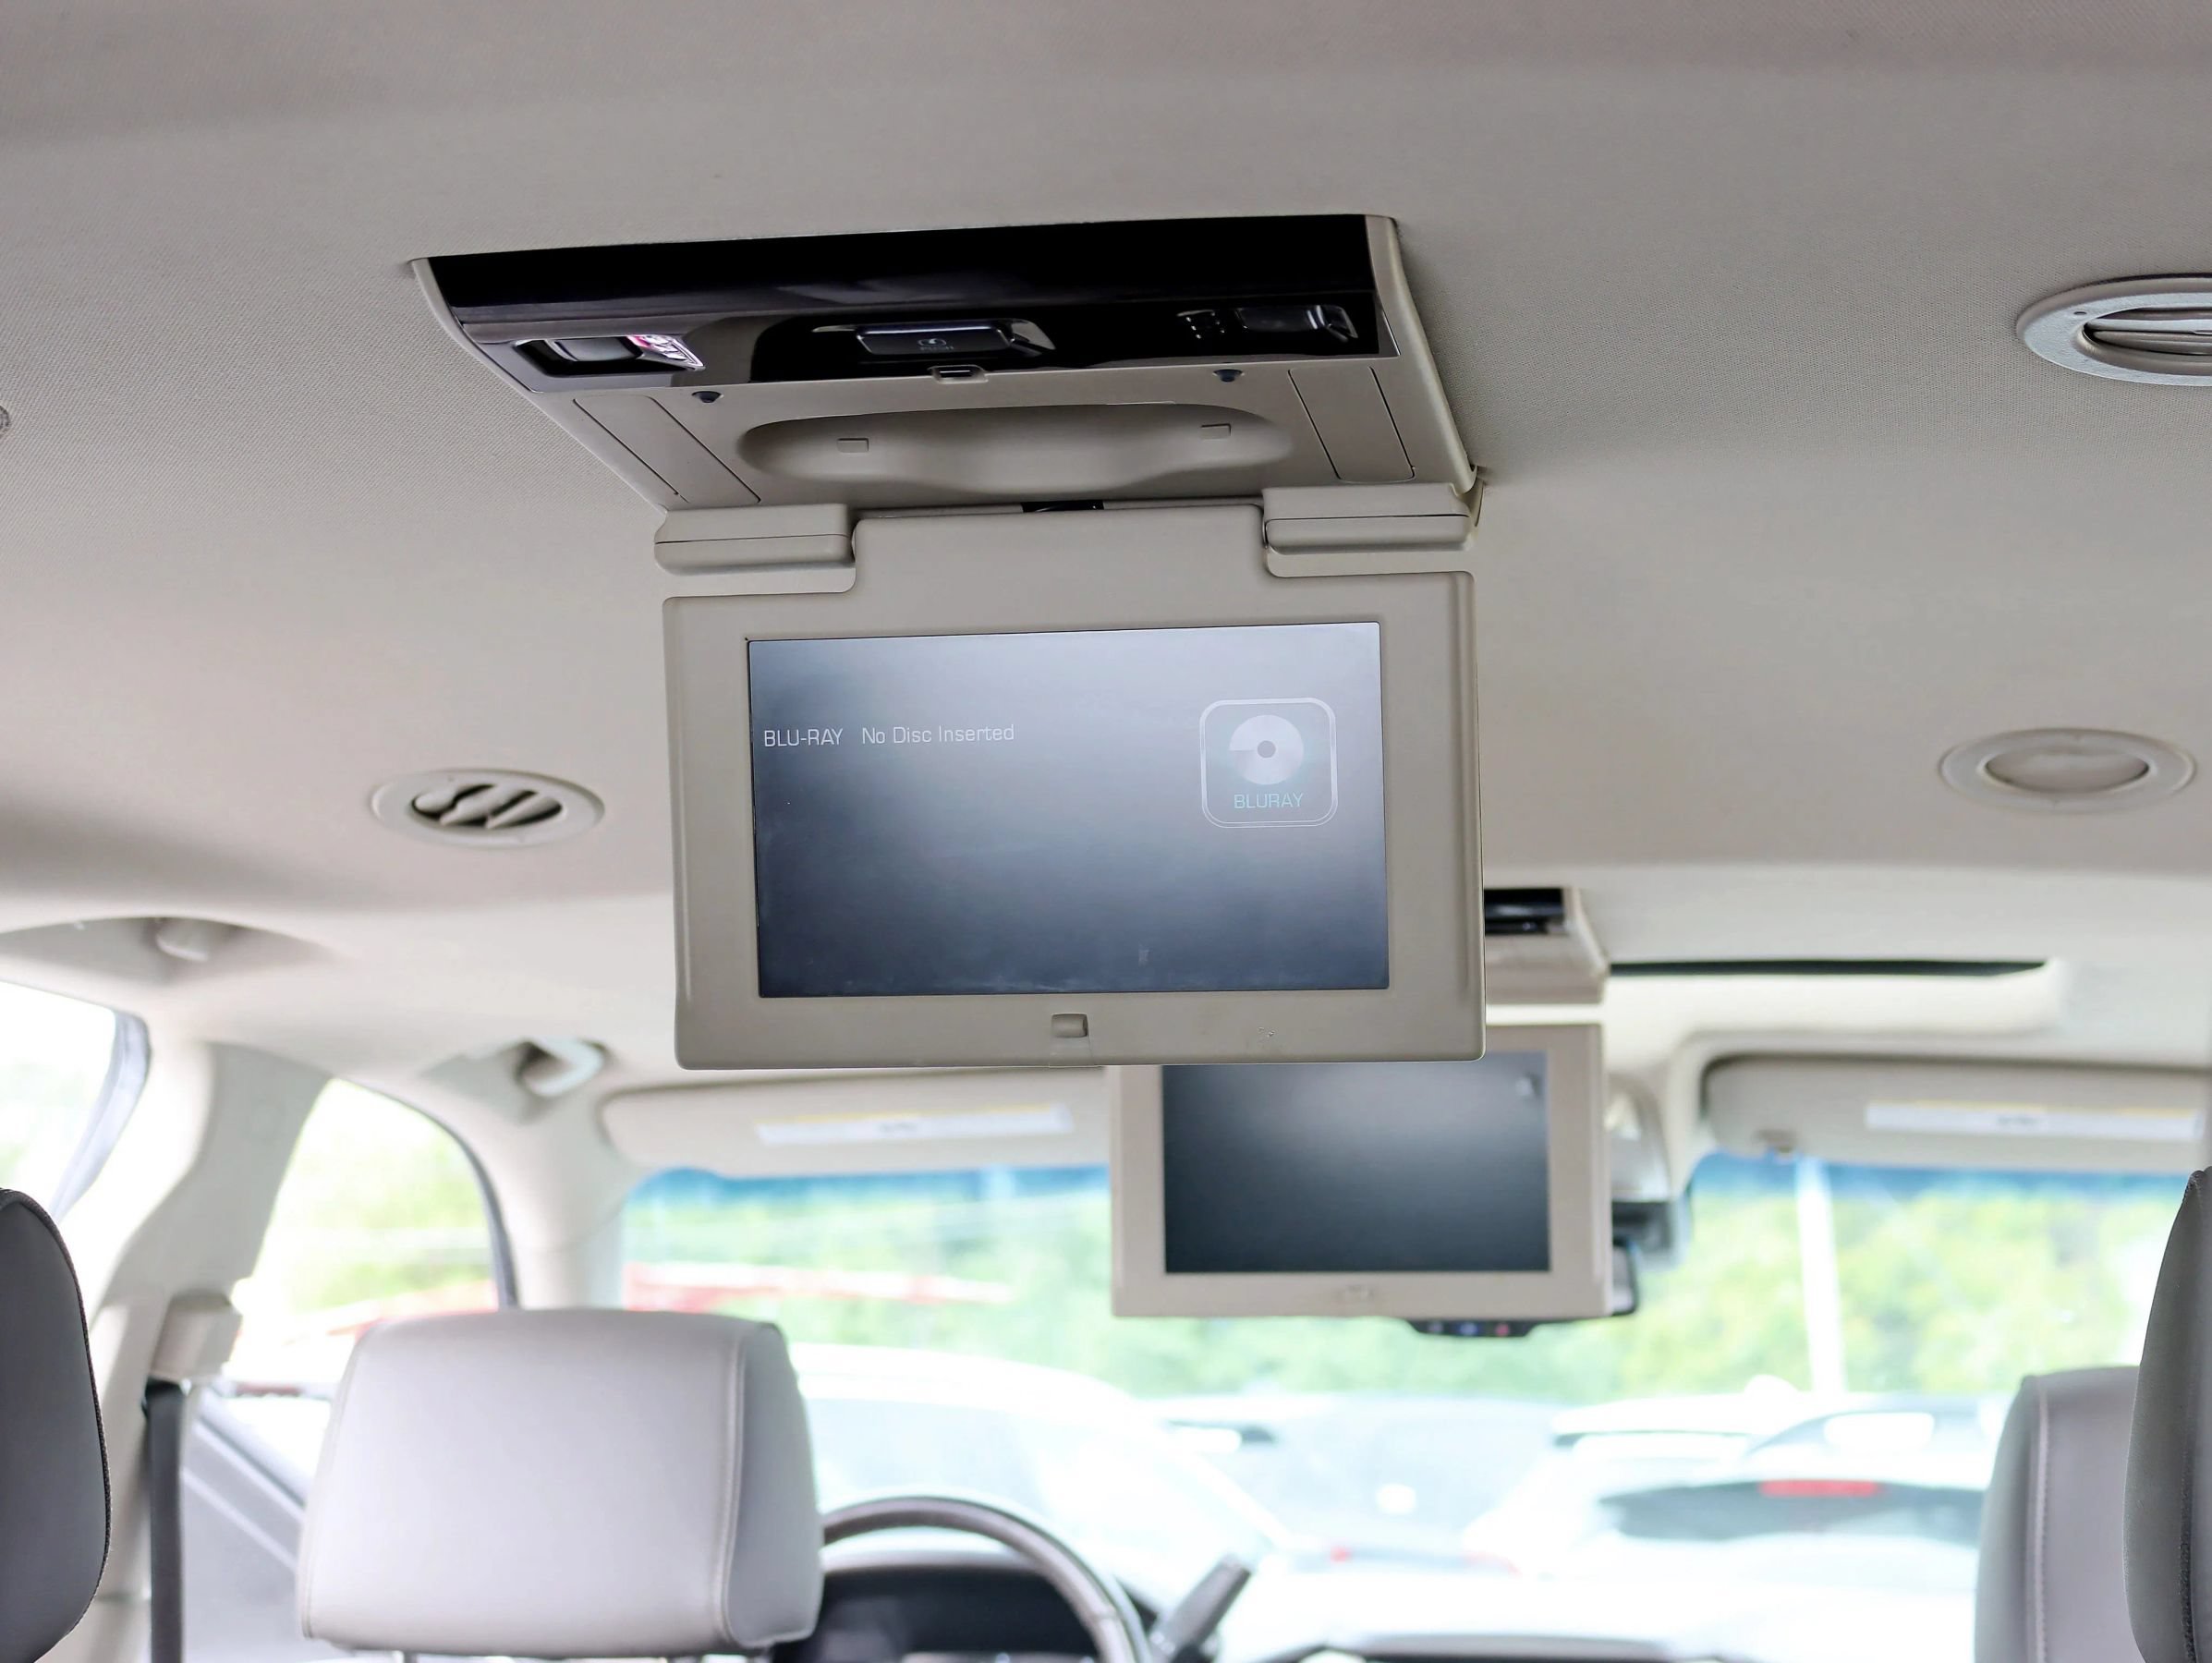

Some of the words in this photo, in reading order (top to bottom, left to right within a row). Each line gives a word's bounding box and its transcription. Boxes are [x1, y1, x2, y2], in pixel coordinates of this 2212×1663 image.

[763, 727, 844, 747] BLU-RAY
[861, 726, 886, 745] No
[893, 725, 932, 744] Disc
[939, 723, 1015, 743] Inserted
[1234, 792, 1305, 809] BLURAY
